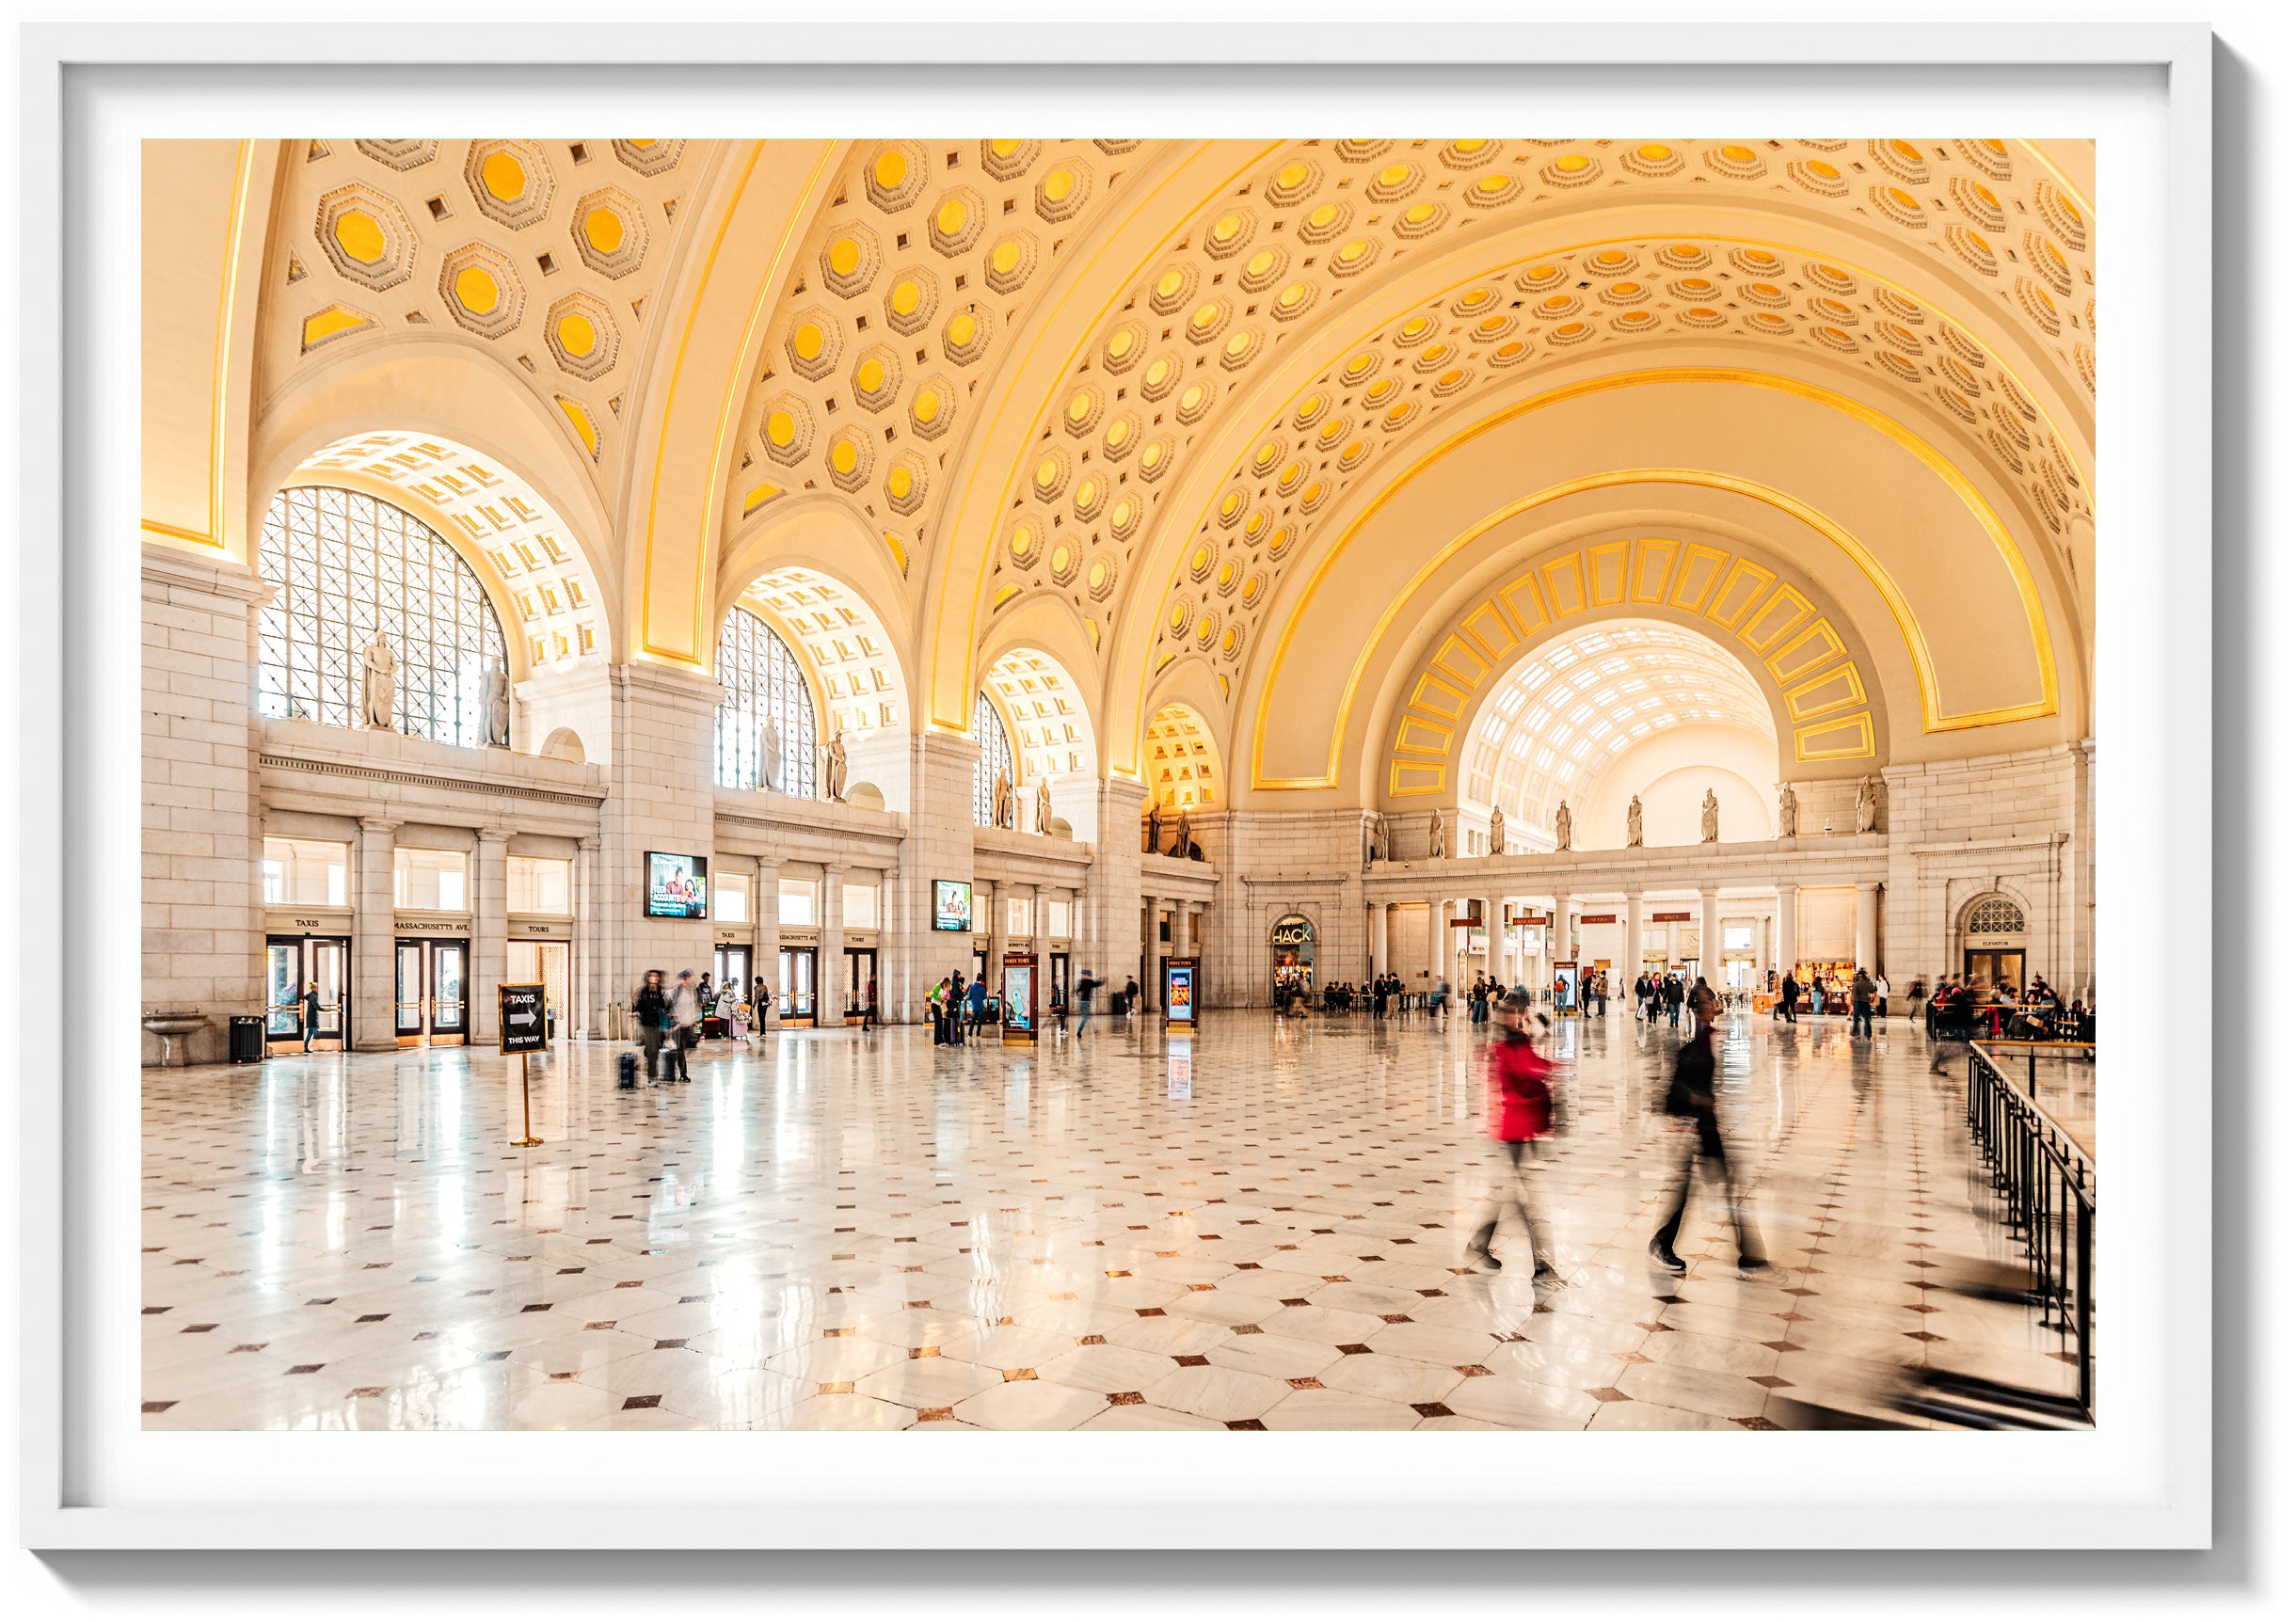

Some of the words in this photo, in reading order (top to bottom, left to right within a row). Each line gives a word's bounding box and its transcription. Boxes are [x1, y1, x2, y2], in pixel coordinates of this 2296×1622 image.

[510, 994, 535, 1004] TAXIS
[508, 1036, 523, 1044] THIS
[524, 1035, 539, 1043] WAY
